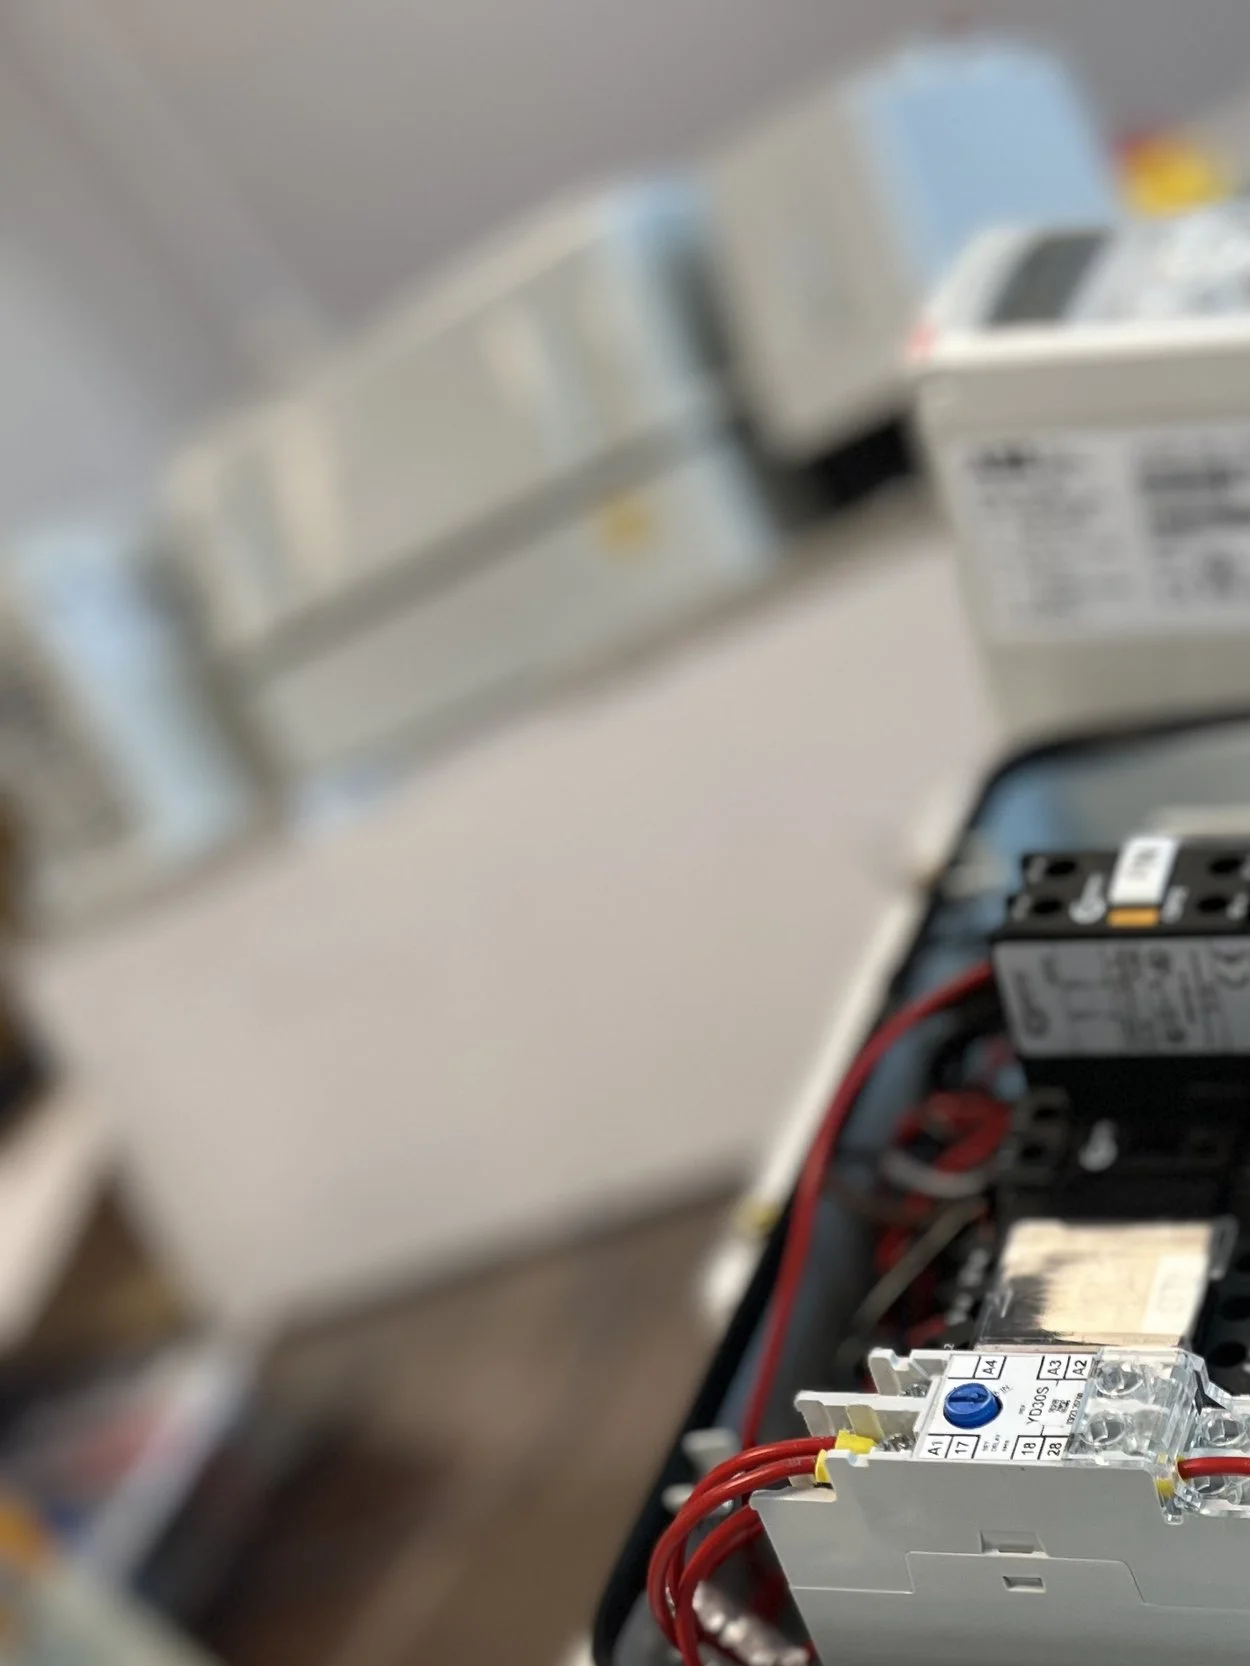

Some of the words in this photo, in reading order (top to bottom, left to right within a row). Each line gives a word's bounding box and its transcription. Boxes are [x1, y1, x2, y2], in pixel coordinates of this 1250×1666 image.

[982, 1360, 997, 1375] A4
[1047, 1360, 1062, 1376] A3
[1072, 1360, 1087, 1376] A2
[1026, 1386, 1050, 1425] YD30S
[928, 1441, 943, 1456] A1
[955, 1441, 969, 1454] 17
[1021, 1442, 1036, 1455] 18
[1047, 1442, 1062, 1456] 28
